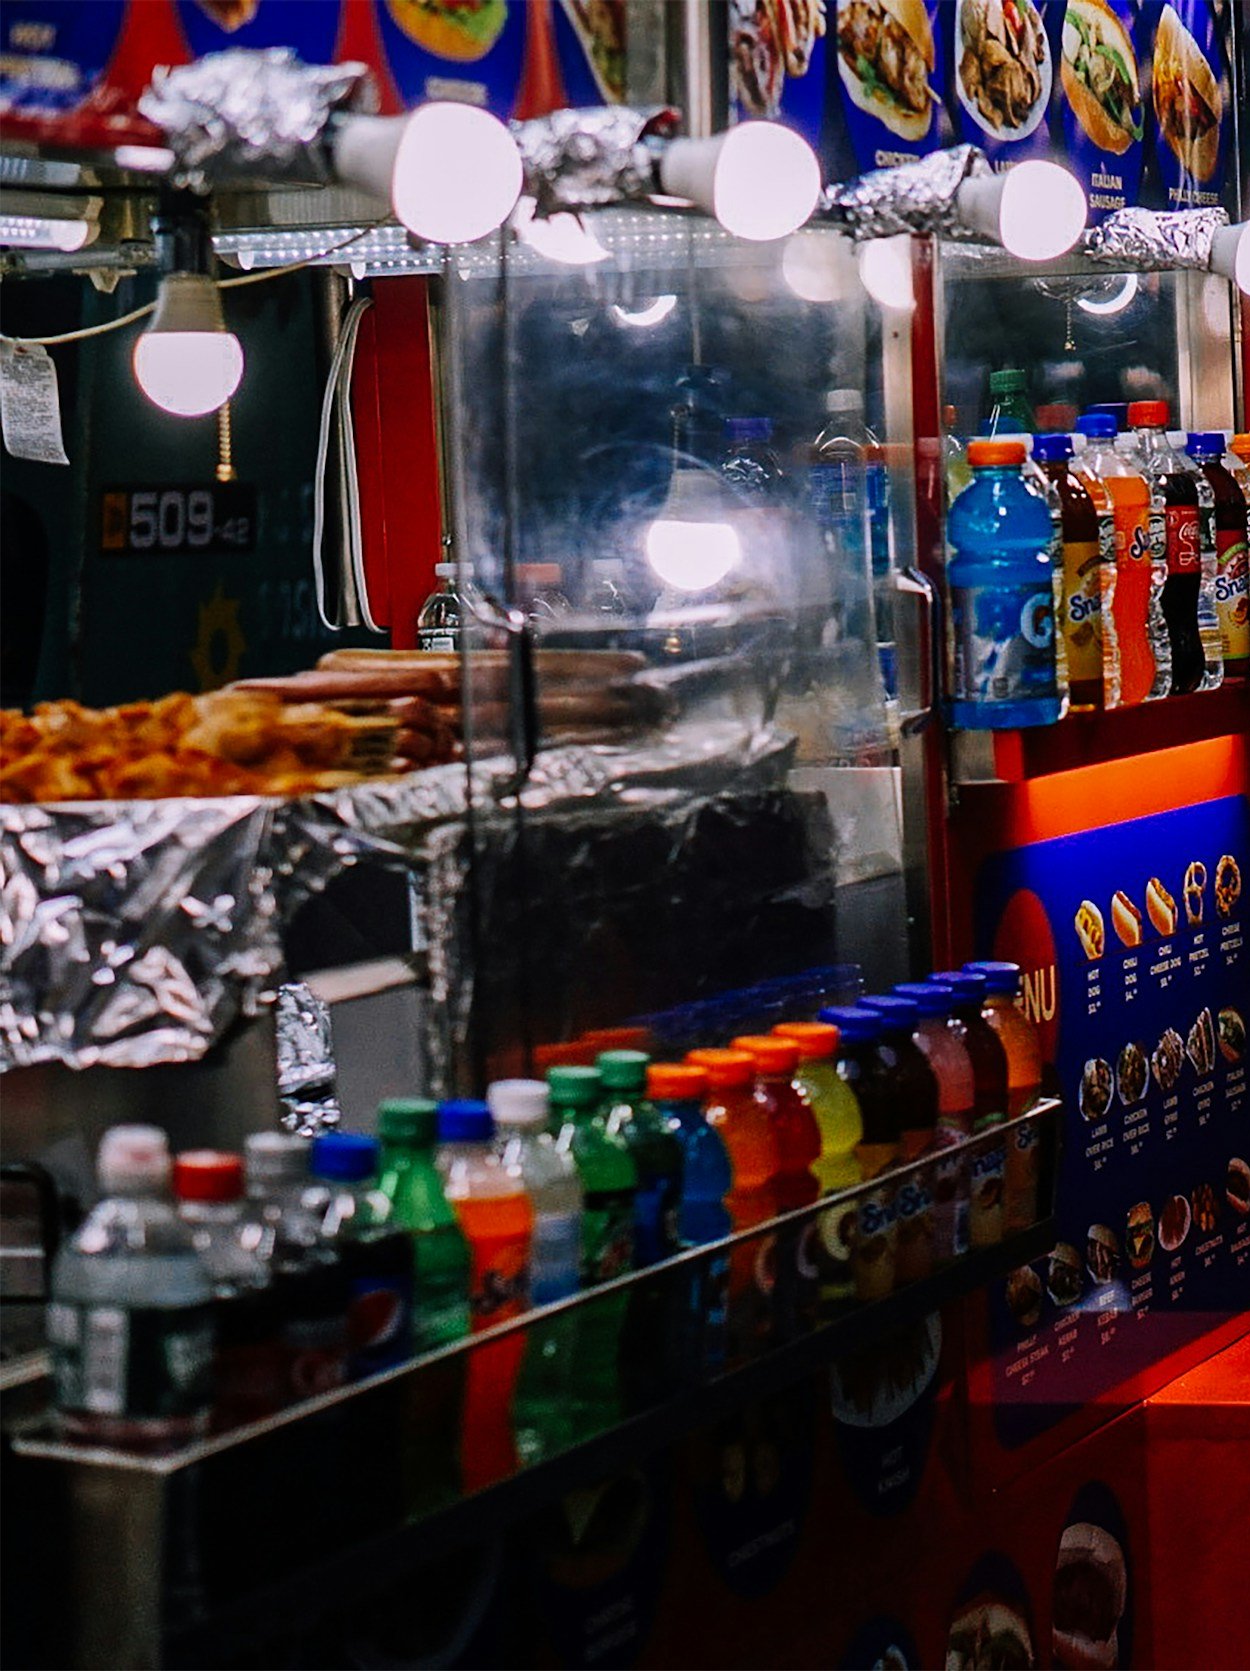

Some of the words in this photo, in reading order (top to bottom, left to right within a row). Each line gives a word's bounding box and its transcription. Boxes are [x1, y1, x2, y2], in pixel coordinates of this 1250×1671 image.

[1091, 172, 1123, 190] ITALIAN
[1089, 193, 1126, 211] SAUSAGE
[1014, 965, 1056, 1024] NU
